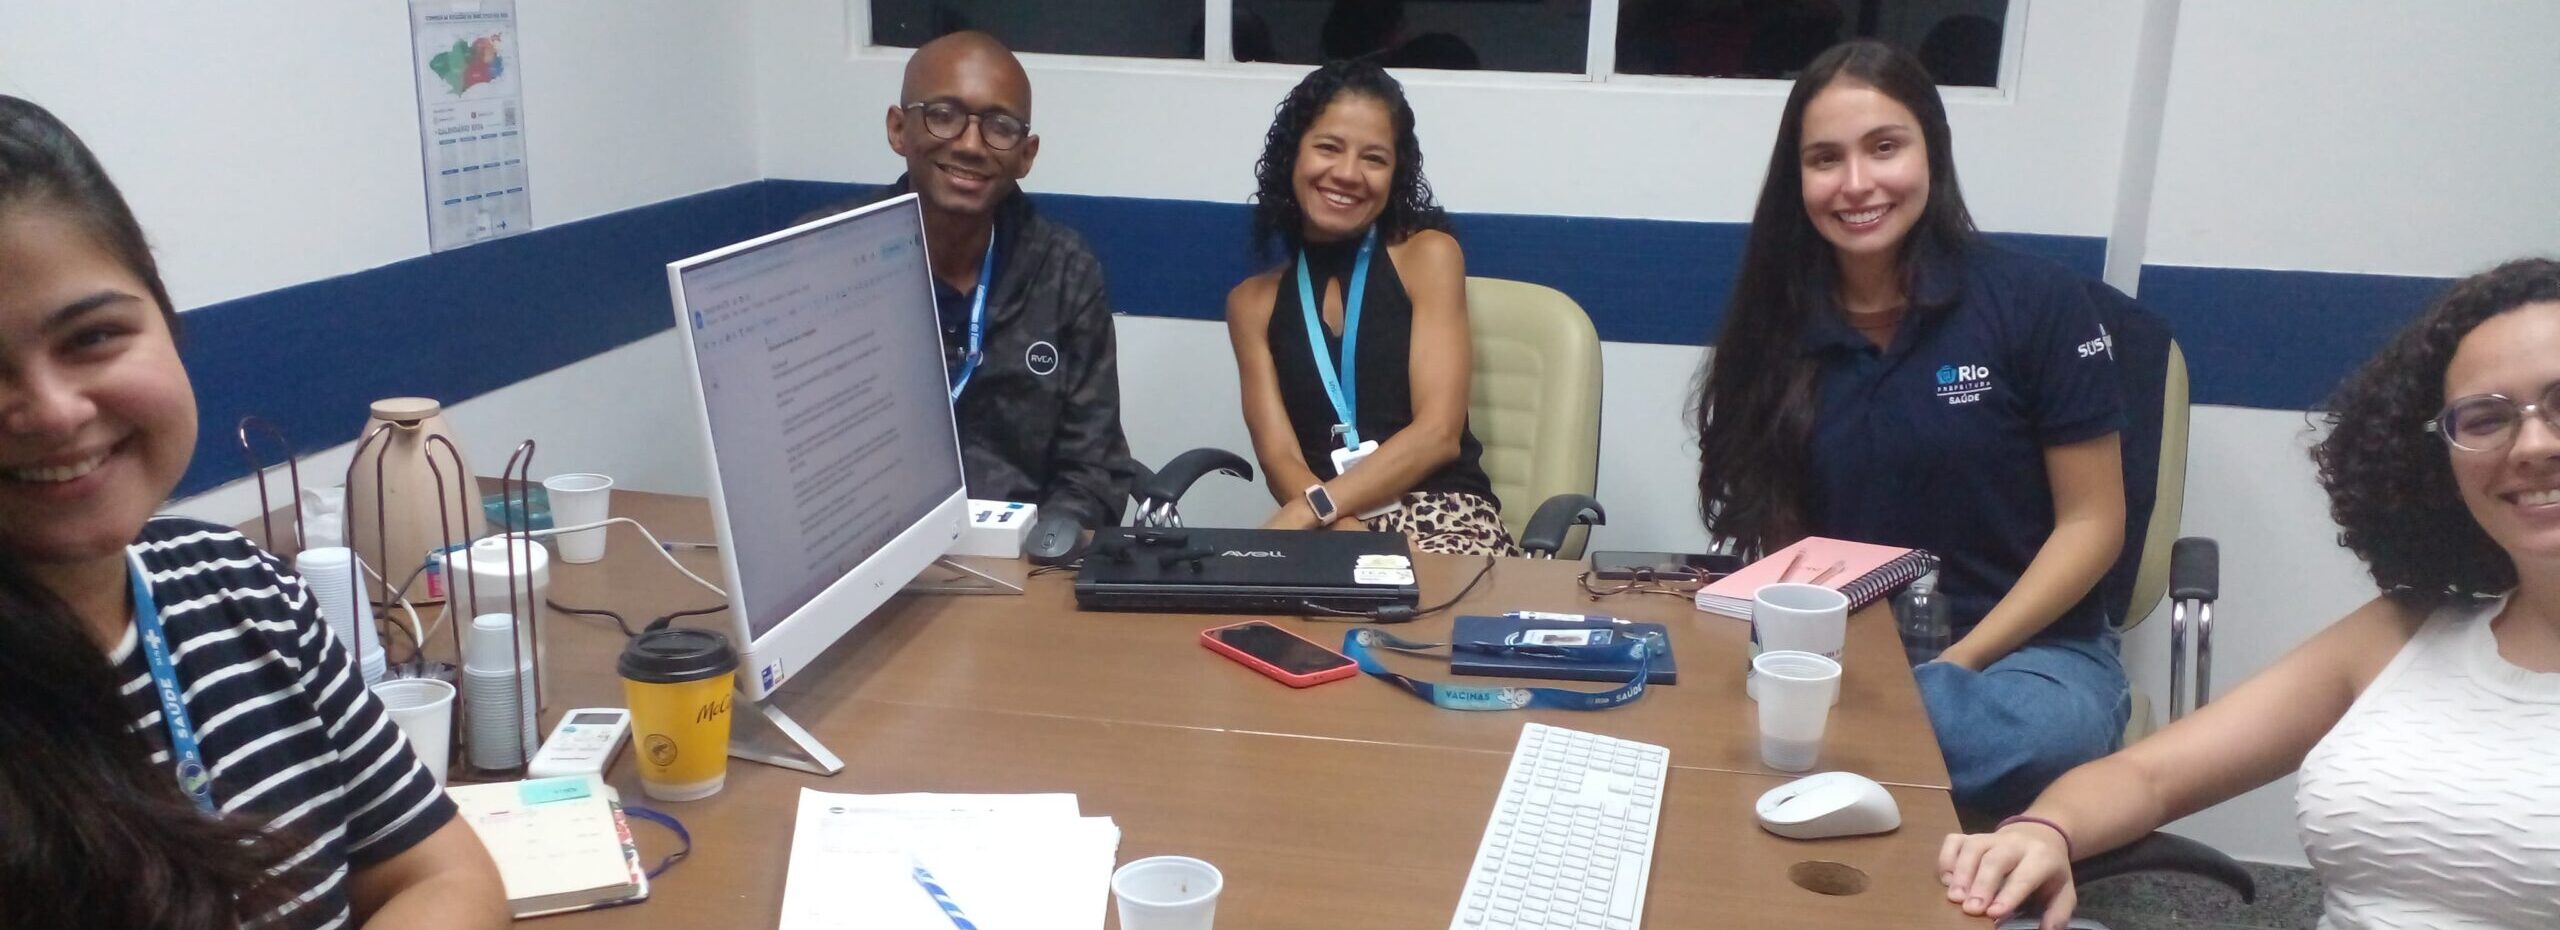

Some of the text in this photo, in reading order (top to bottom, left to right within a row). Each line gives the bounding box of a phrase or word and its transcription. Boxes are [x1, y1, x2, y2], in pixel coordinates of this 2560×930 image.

[2077, 337, 2105, 358] SUS
[1031, 353, 1054, 364] RVCA
[1958, 364, 1989, 382] Rio
[1948, 393, 1980, 404] SAÚDE
[1446, 690, 1490, 701] VACINAS
[160, 678, 189, 738] SAÚDE
